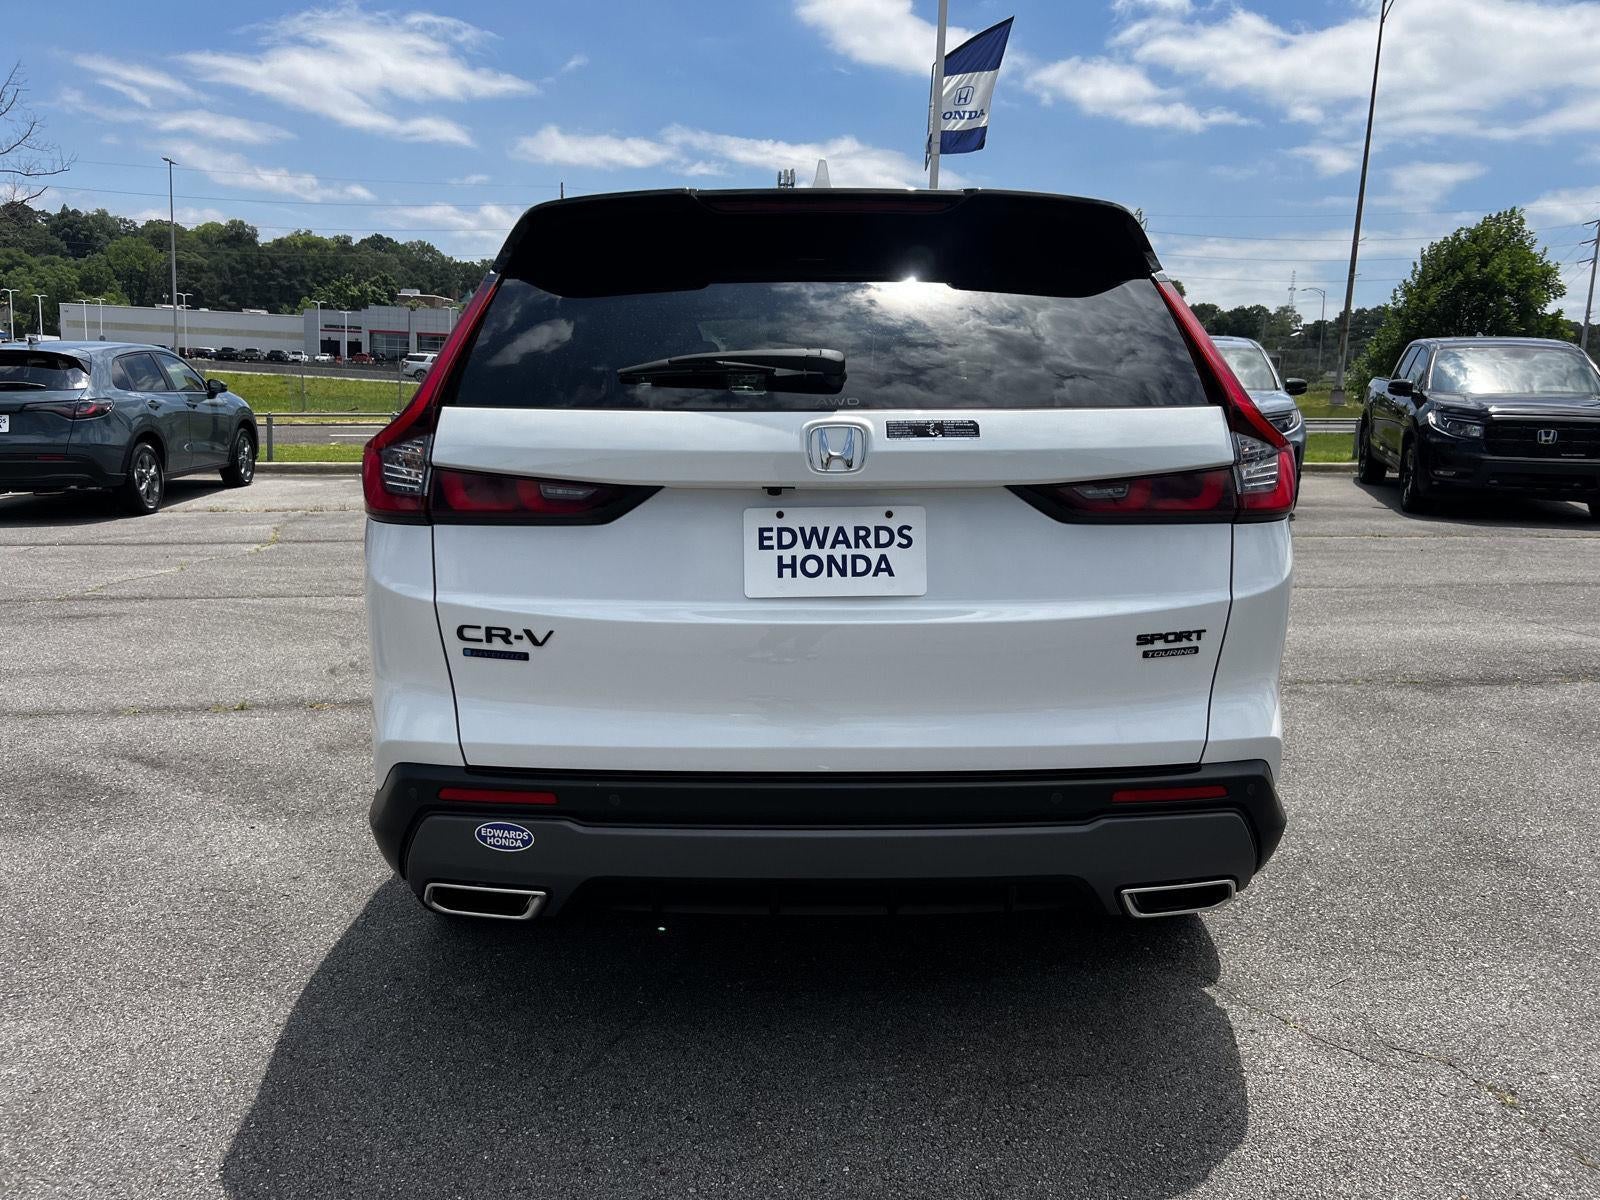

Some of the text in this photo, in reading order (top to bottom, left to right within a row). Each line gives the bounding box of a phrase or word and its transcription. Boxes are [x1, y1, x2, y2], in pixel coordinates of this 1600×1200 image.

[941, 109, 985, 120] ONDA
[816, 398, 860, 406] AWD
[758, 525, 913, 550] EDWARDS
[777, 554, 895, 578] HONDA
[456, 624, 554, 647] CR-V
[1136, 629, 1206, 646] SPORT
[1147, 648, 1196, 657] TOURING
[481, 828, 528, 839] EDWARDS
[487, 837, 523, 847] HONDA
